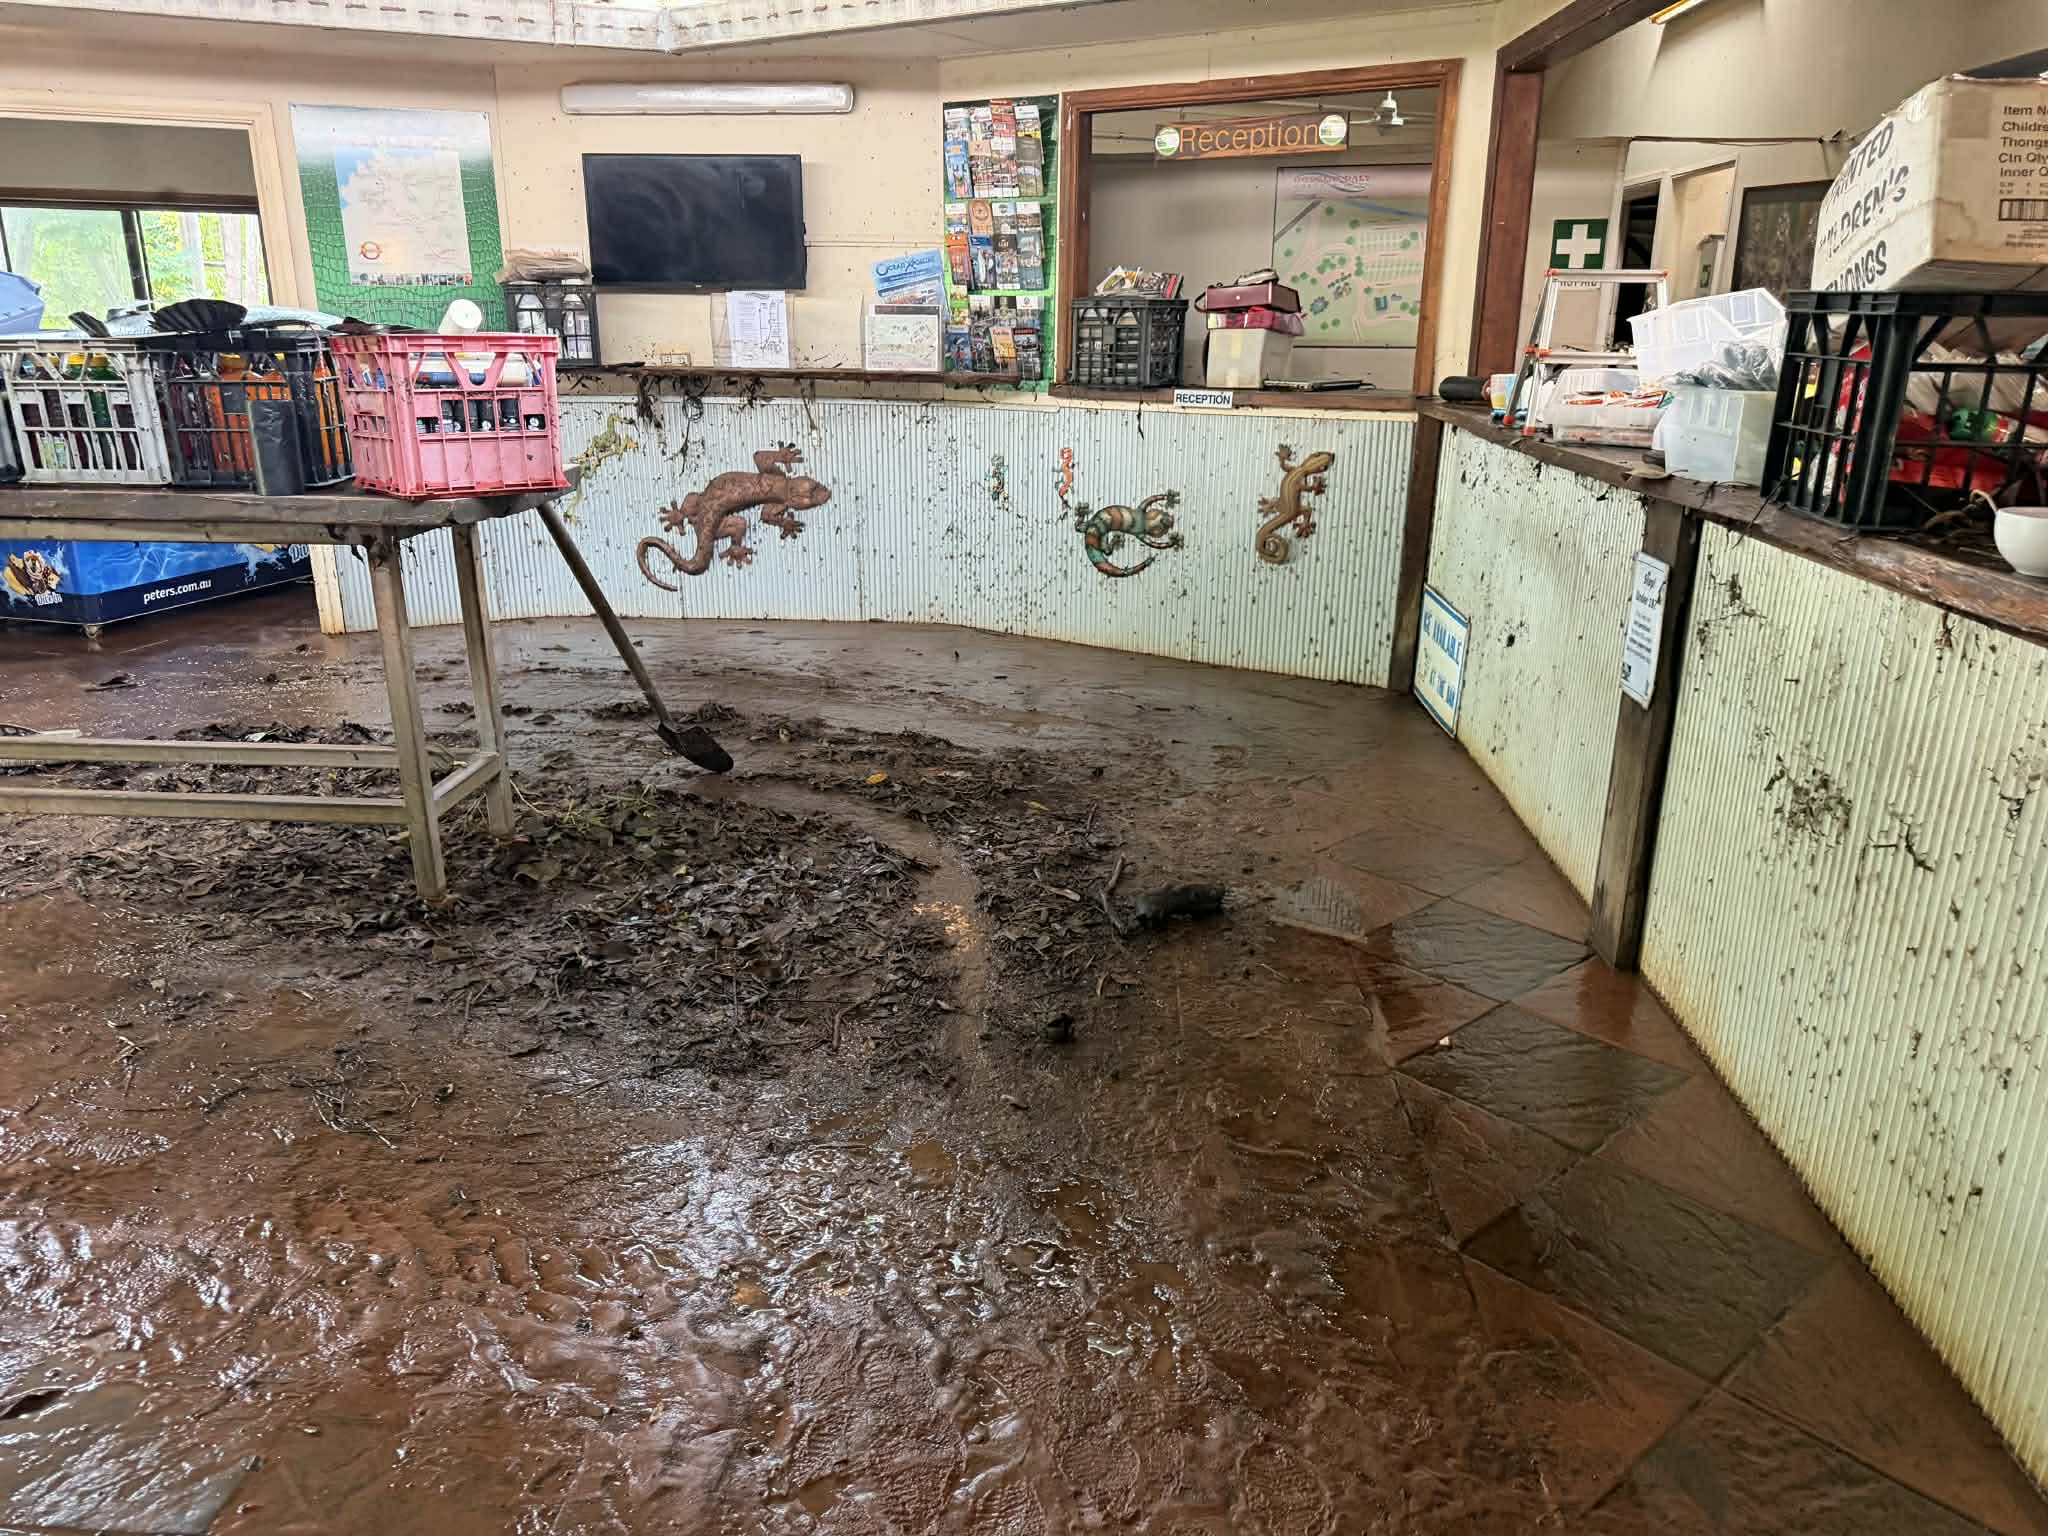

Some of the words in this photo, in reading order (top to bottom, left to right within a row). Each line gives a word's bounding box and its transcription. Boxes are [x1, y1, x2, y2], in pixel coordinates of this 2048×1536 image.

[2003, 105, 2033, 115] Item
[2037, 105, 2048, 115] N
[1179, 121, 1319, 152] Reception
[2000, 167, 2035, 177] Inner
[1825, 240, 1887, 291] HONGS
[1176, 393, 1231, 405] RECEPTION
[143, 579, 212, 605] peters.com.au
